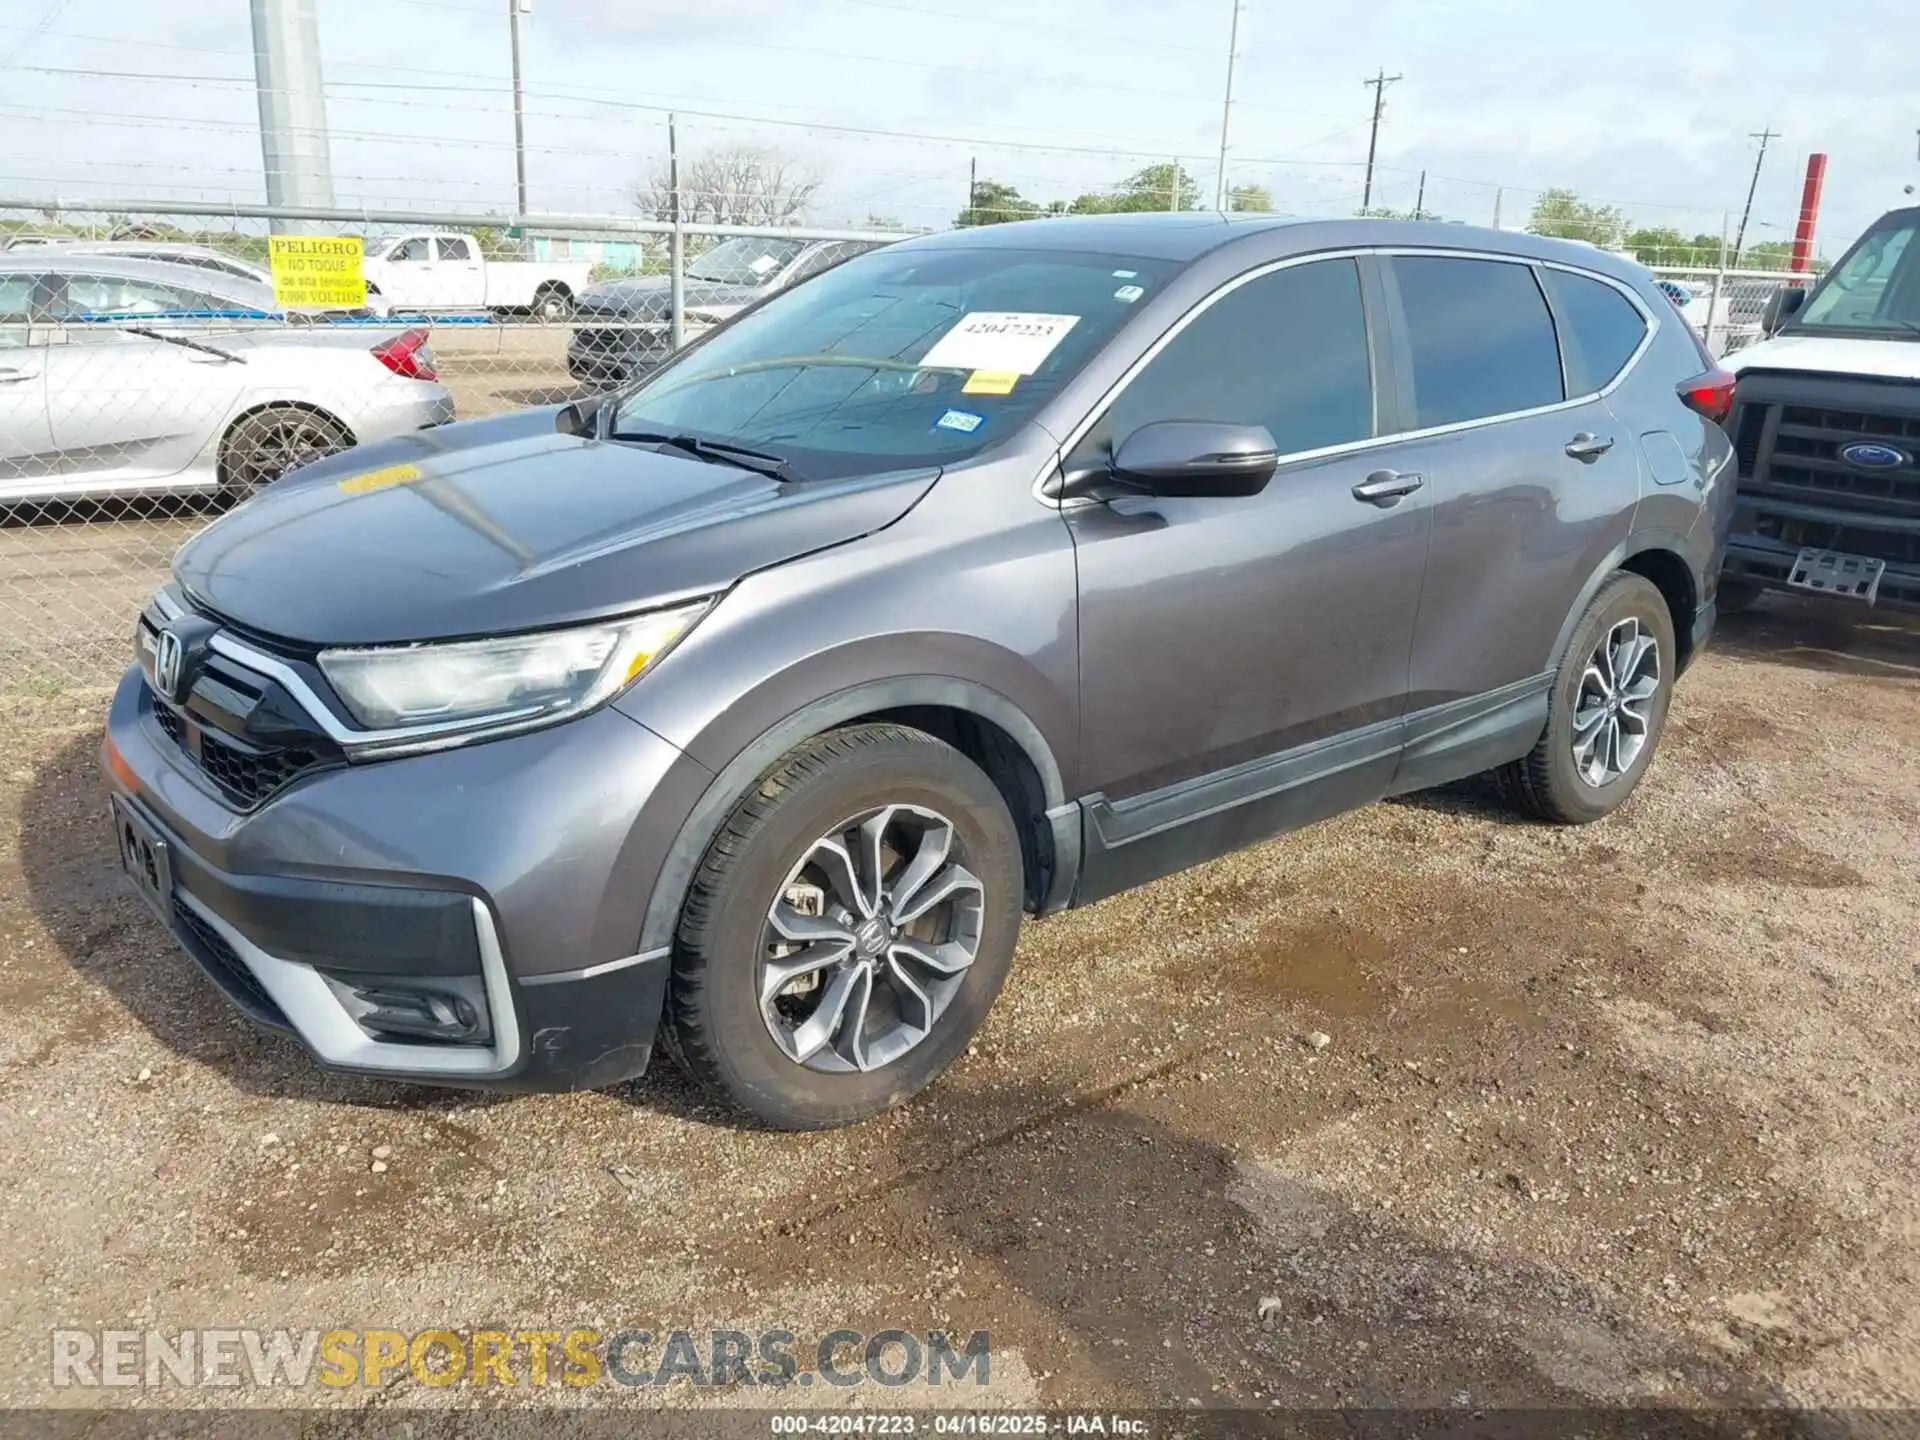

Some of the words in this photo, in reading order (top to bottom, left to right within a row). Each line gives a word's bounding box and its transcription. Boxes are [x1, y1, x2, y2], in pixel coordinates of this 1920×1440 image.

[275, 240, 358, 255] PELIGRO
[288, 259, 305, 271] NO
[308, 260, 348, 272] TOQUE
[309, 291, 361, 304] VOLTIOS
